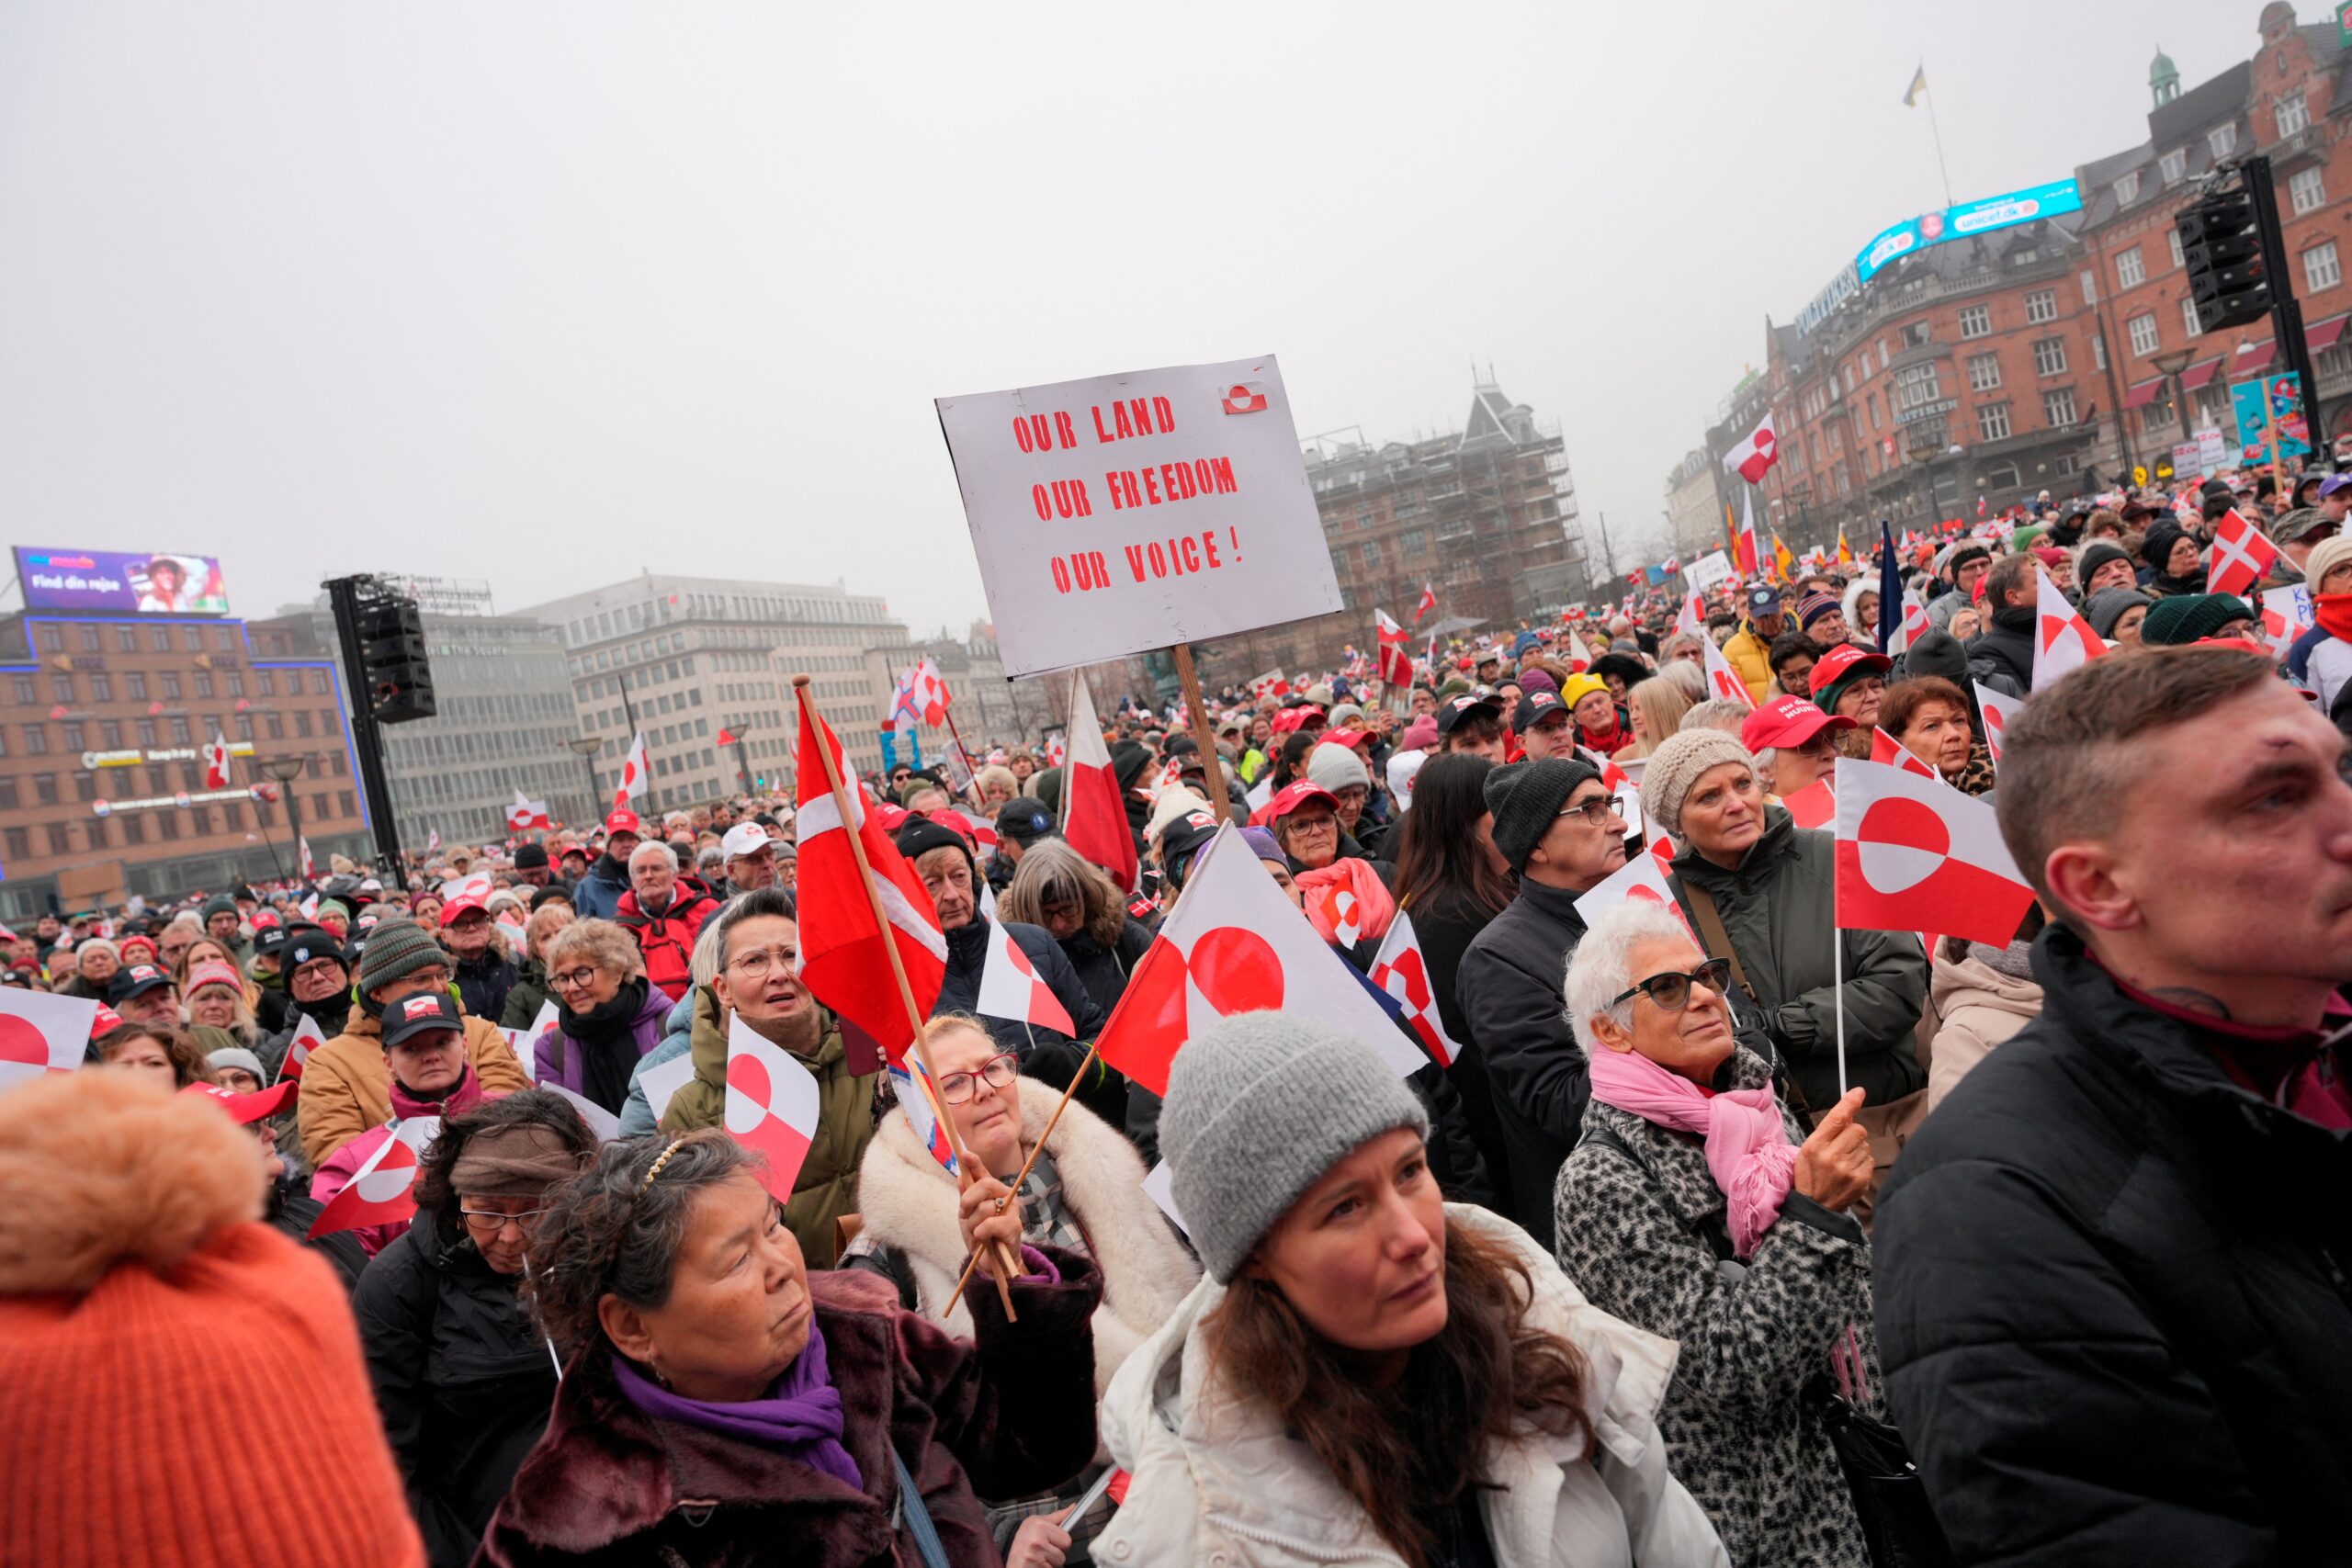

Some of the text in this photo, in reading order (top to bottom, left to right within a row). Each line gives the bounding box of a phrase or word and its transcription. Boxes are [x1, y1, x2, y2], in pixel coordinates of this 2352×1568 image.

[1012, 396, 1176, 454] OUR LAND
[1032, 456, 1238, 522] OUR FREEDOM
[31, 573, 121, 593] Find din rejse
[1050, 550, 1112, 594] OUR
